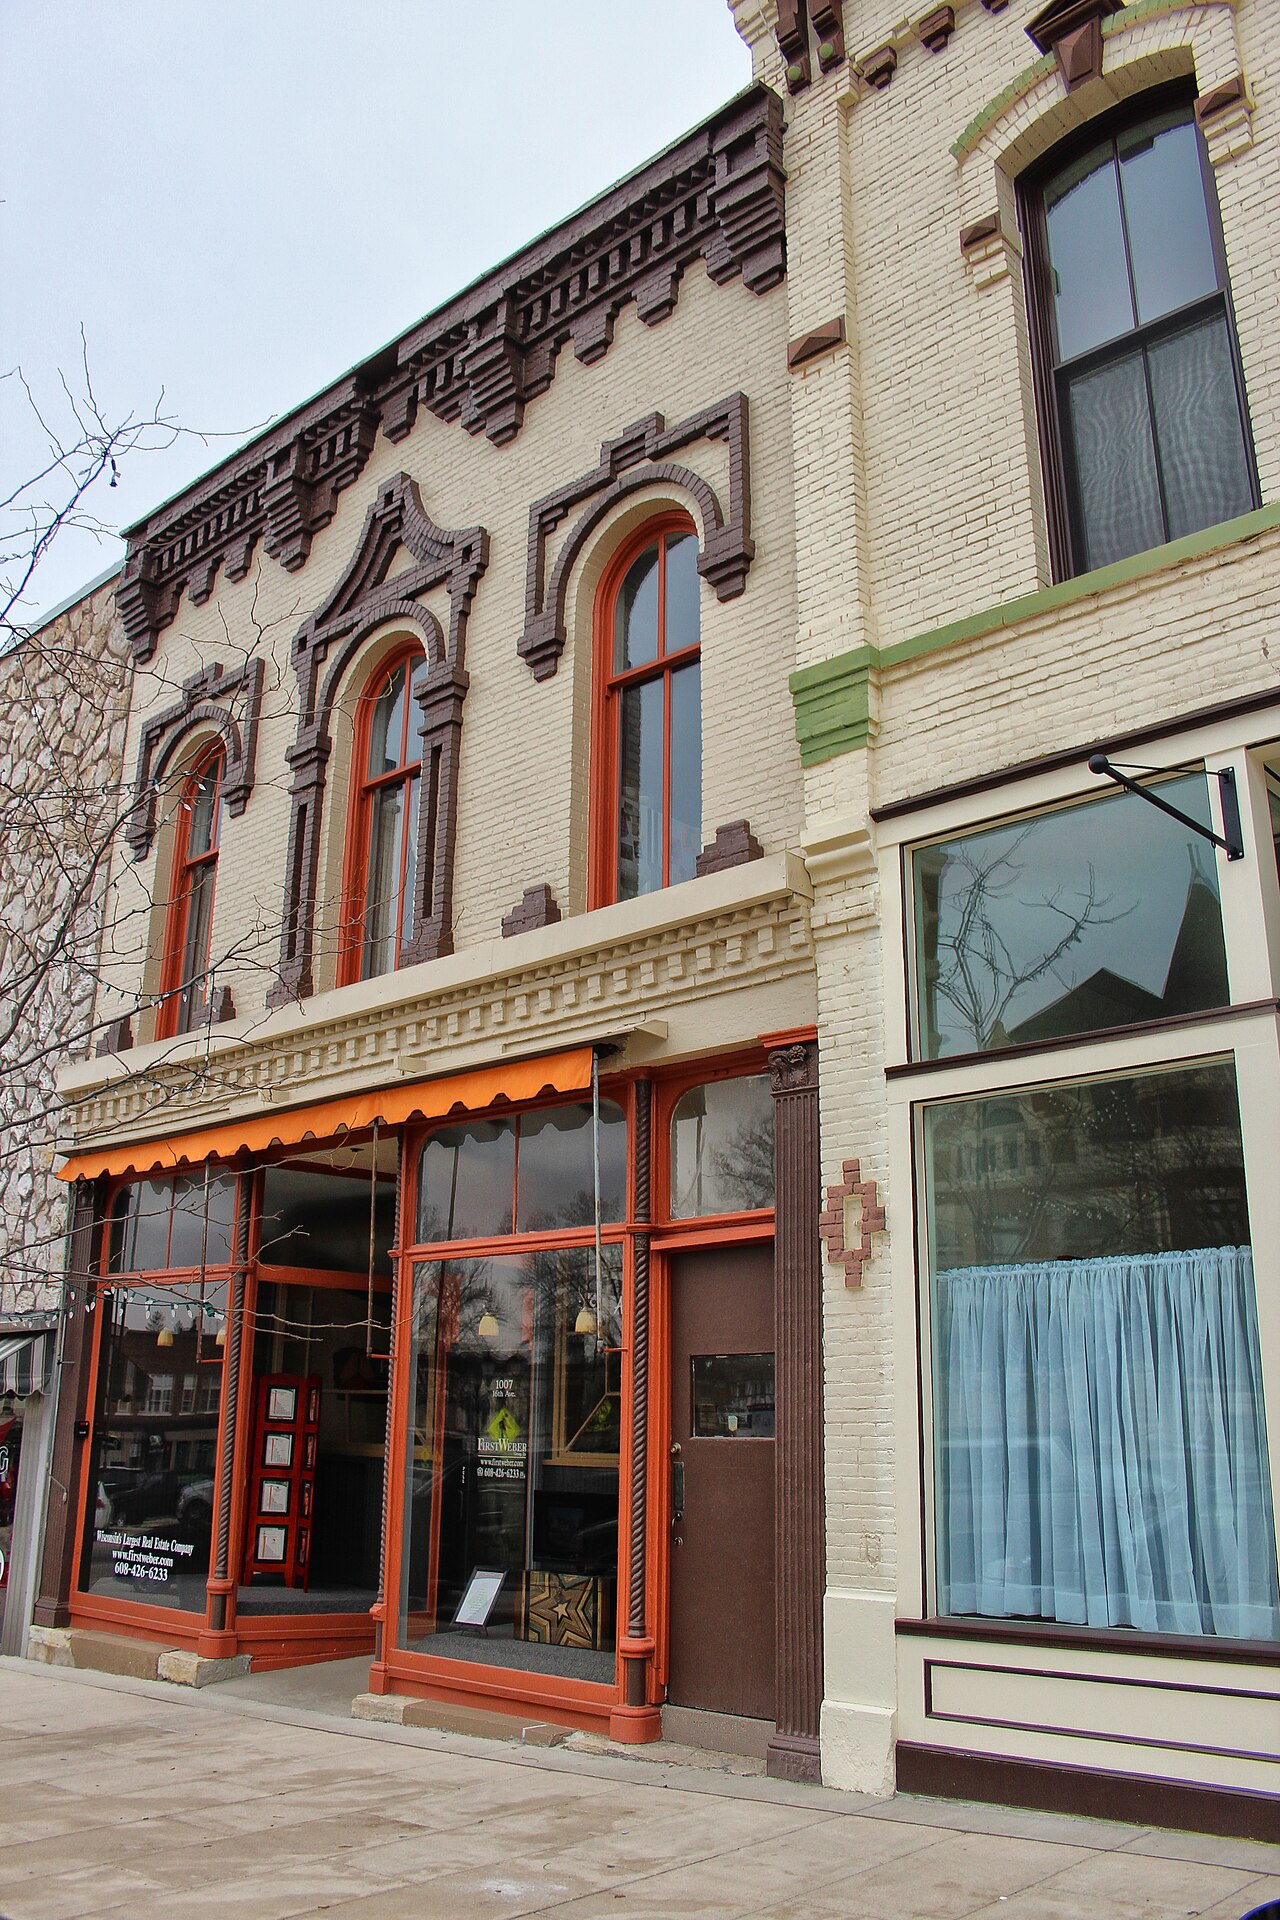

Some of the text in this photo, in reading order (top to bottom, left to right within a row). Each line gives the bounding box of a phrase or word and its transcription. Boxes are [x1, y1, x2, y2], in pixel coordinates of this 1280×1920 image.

[495, 1379, 513, 1389] 1007
[480, 1458, 524, 1467] www.firstweber.com
[484, 1468, 519, 1478] 608-426-6233
[96, 1530, 194, 1556] Wisconsin's Largest Real Estate Company
[112, 1550, 173, 1567] www.firstweber.com
[114, 1562, 168, 1581] 608-426-6233
